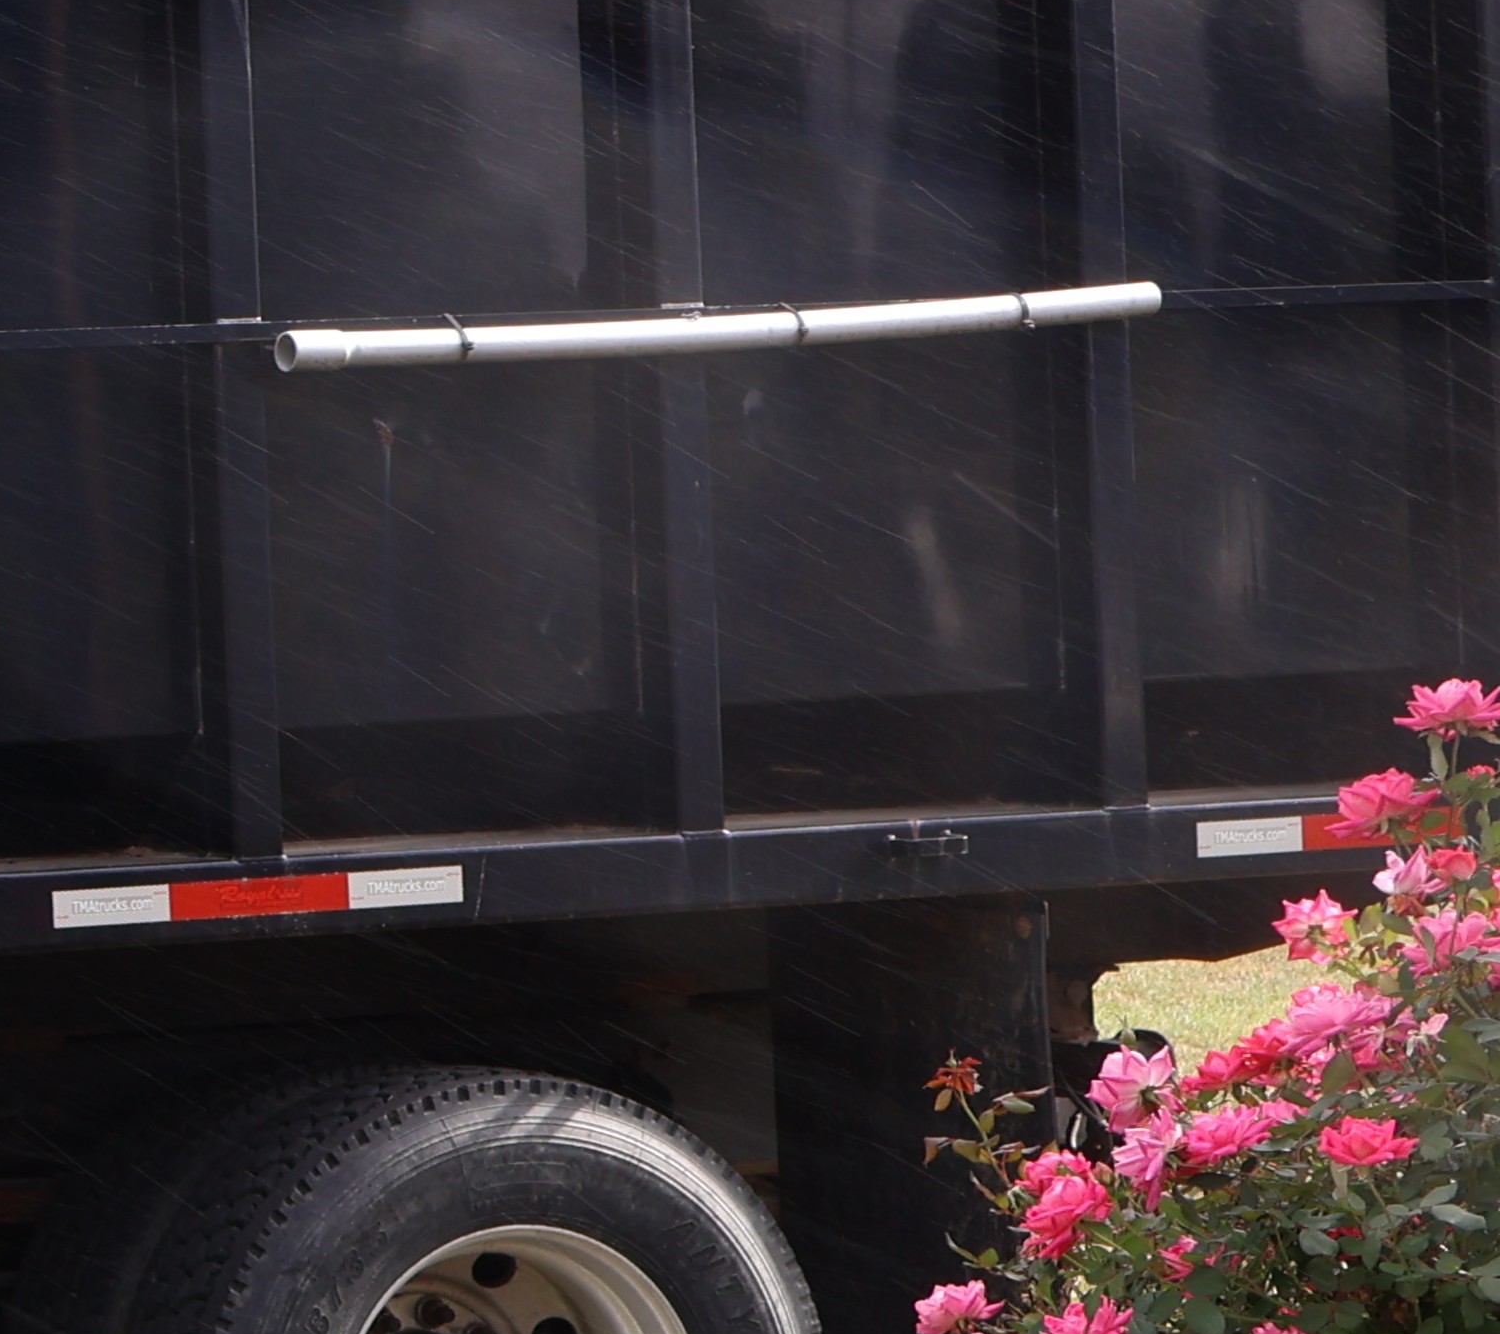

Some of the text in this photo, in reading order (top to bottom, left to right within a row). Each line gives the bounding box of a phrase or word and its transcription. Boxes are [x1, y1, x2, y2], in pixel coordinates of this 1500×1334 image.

[1214, 828, 1288, 844] TMAtrucks.com
[368, 878, 446, 896] TMAtrucks.com
[71, 896, 154, 915] TMAtrucks.com
